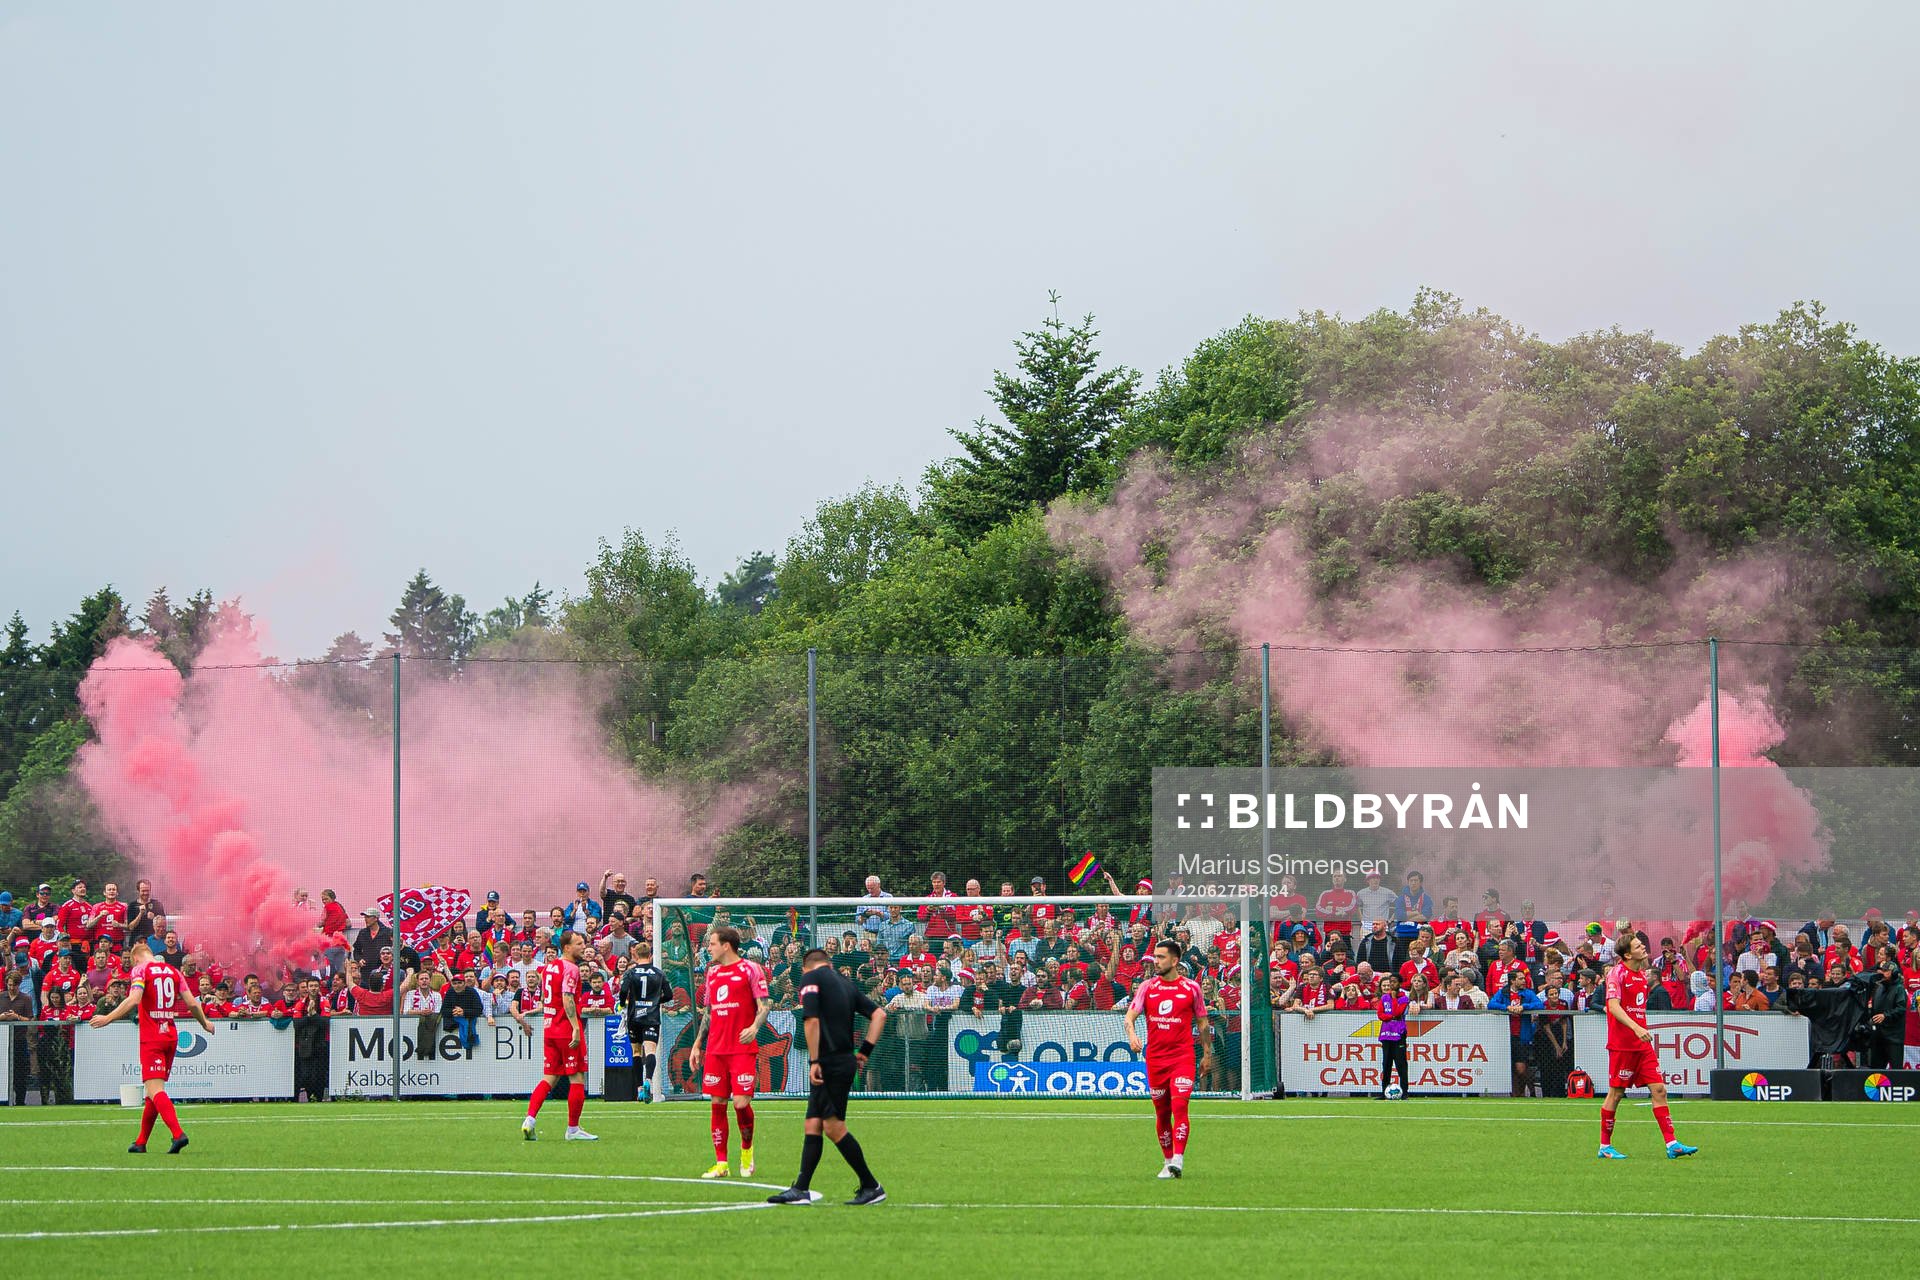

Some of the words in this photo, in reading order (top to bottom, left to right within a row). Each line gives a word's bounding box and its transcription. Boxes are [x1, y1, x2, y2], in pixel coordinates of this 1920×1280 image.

[154, 976, 175, 1009] 19
[543, 973, 553, 1005] 5
[640, 975, 648, 999] 1
[609, 1056, 629, 1064] OBOS
[1046, 1070, 1147, 1093] OBOS
[1757, 1085, 1792, 1101] NEP
[1880, 1086, 1916, 1102] NEP
